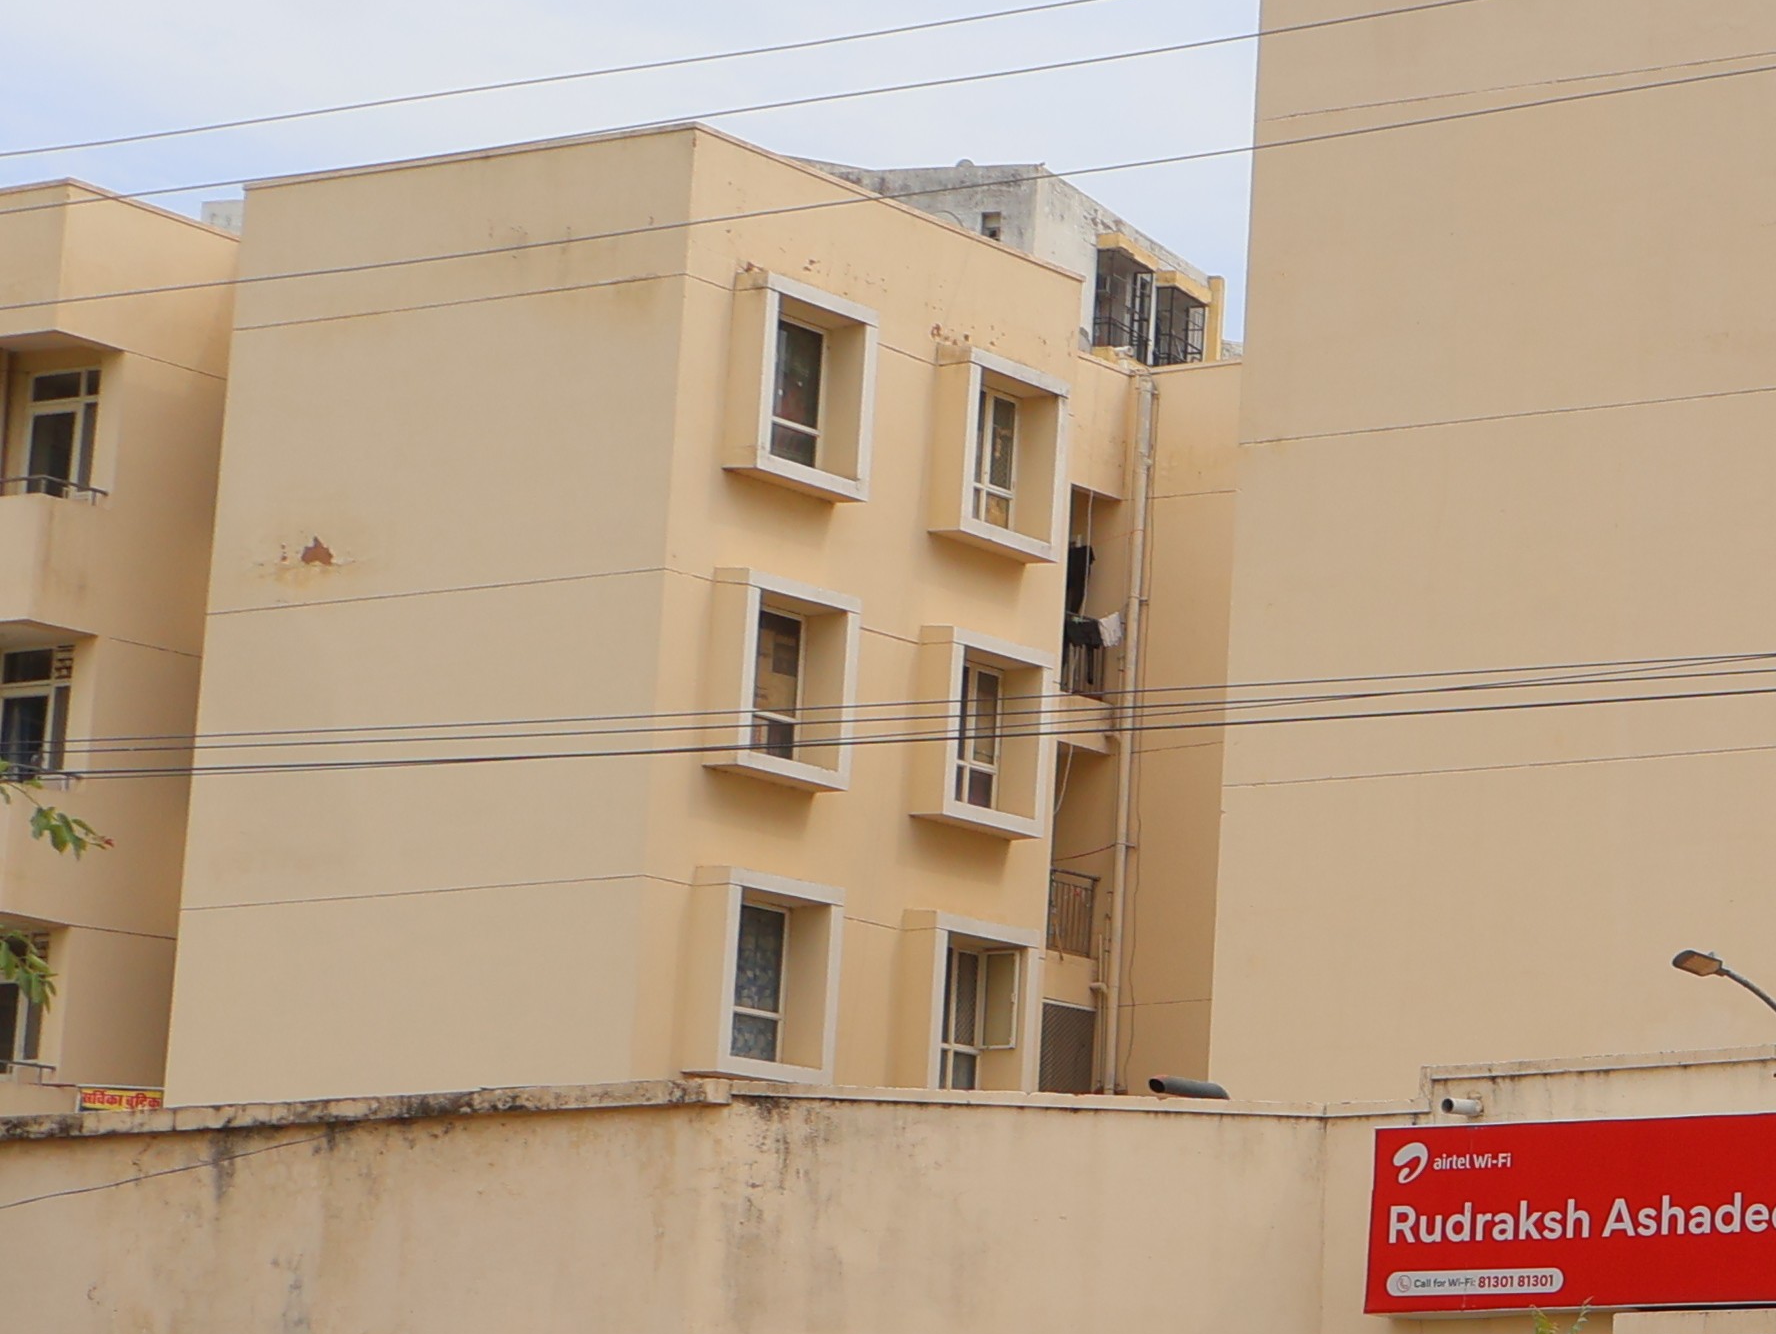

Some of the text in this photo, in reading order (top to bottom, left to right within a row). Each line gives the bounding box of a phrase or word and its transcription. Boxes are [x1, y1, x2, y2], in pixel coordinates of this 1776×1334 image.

[1433, 1152, 1511, 1170] airtel Wi-Fi
[1388, 1198, 1590, 1244] Rudraksh
[1413, 1277, 1431, 1288] Call
[1433, 1277, 1447, 1288] for
[1478, 1274, 1514, 1288] 81301
[1517, 1274, 1554, 1288] 81301
